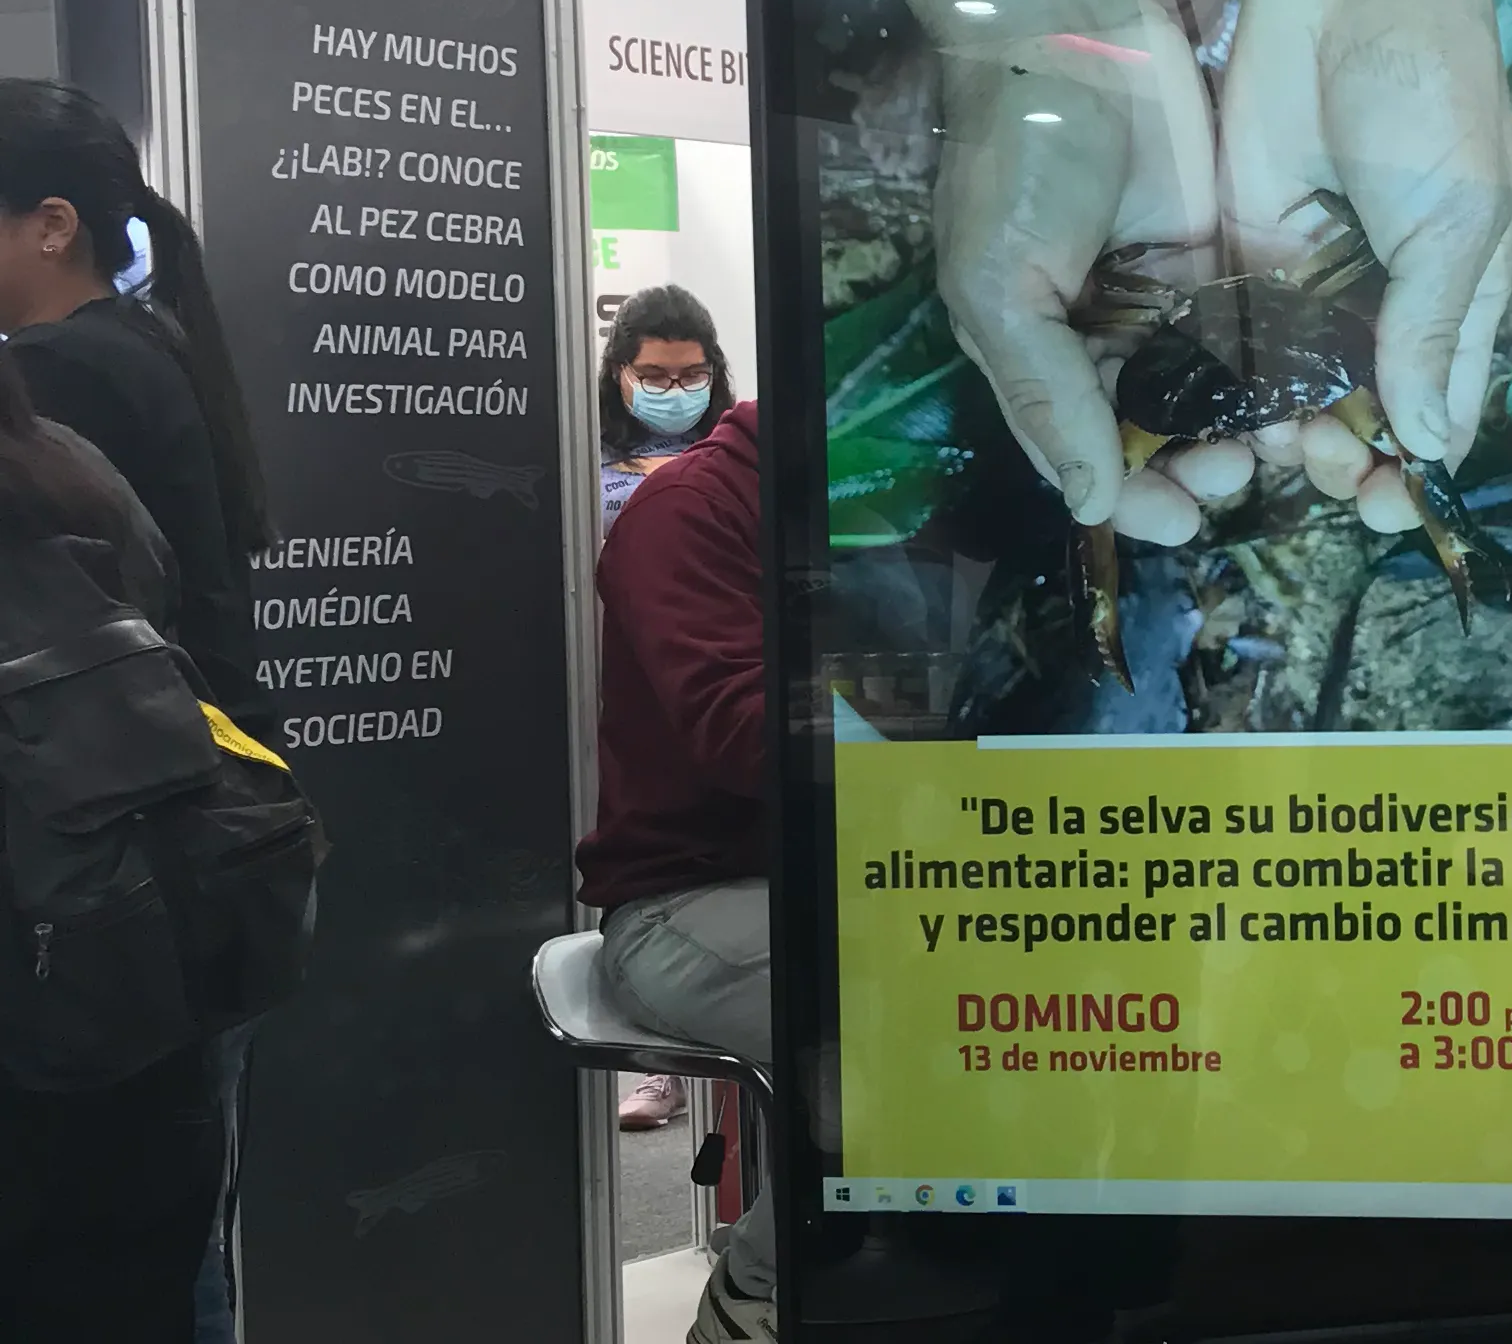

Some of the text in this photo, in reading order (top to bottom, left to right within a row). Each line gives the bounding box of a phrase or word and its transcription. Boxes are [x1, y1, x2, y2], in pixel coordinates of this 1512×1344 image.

[312, 23, 519, 78] HAY MUCHOS
[608, 35, 749, 86] SCIENCE BI
[291, 80, 512, 133] PECES EN EL...
[271, 145, 523, 192] ¿¡LAB!? CONOCE
[310, 202, 525, 247] AL PEZ CEBRA
[288, 261, 527, 304] COMO MODELO
[313, 322, 528, 361] ANIMAL PARA
[286, 375, 529, 417] INVESTIGACIÓN
[249, 527, 414, 571] GENIERÍA
[254, 587, 413, 631] IOMÉDICA
[255, 649, 453, 690] AYETANO EN
[283, 707, 442, 749] SOCIEDAD
[960, 795, 1034, 836] "De
[1047, 795, 1087, 836] la
[1099, 793, 1212, 836] selva
[1225, 800, 1274, 836] su
[863, 848, 1130, 892] alimentaria:
[1144, 856, 1240, 899] para
[1251, 847, 1453, 890] combatir
[1465, 846, 1504, 887] la
[918, 913, 943, 954] y
[956, 902, 1177, 954] responder
[1189, 901, 1226, 943] al
[1238, 901, 1401, 943] cambio
[957, 992, 1180, 1035] DOMINGO
[1400, 988, 1492, 1028] 2:00
[957, 1042, 1223, 1074] 13 de noviembre
[1399, 1038, 1422, 1072] a
